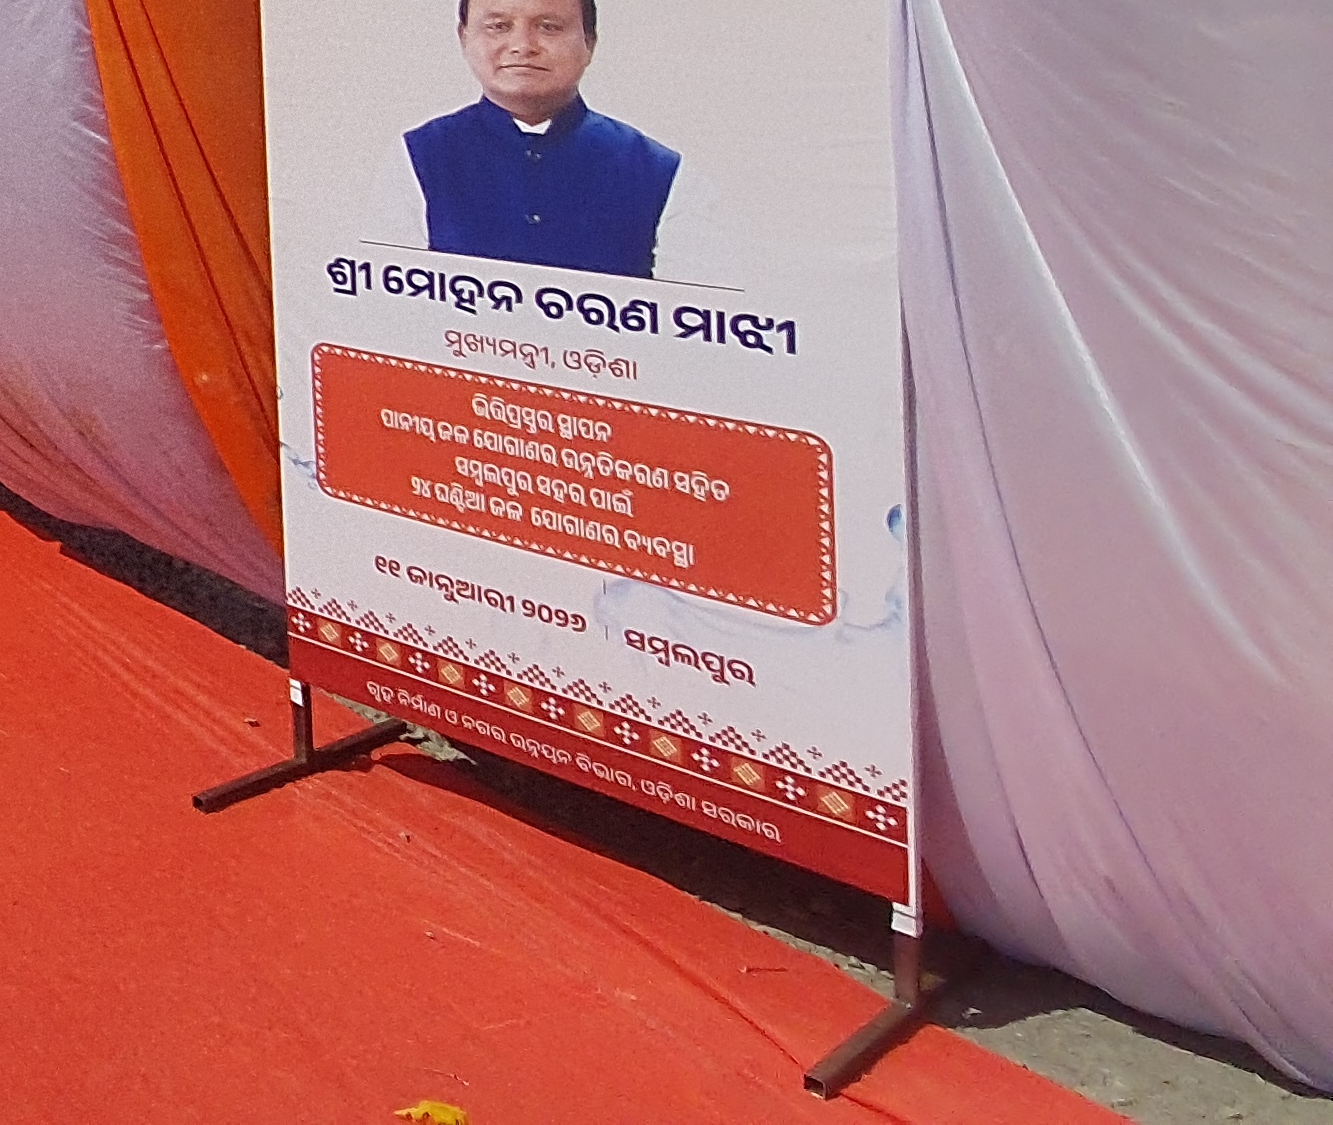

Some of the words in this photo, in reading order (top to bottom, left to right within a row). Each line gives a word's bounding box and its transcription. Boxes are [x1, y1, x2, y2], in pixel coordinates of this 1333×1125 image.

[327, 257, 372, 295] ଶ୍ରୀ
[383, 265, 523, 315] ମୋହନ
[535, 287, 659, 334] ଚରଣ
[672, 306, 797, 355] ମାଝୀ
[444, 329, 556, 369] ମୁଖ୍ୟମନ୍ତ୍ରୀ,
[563, 349, 637, 380] ଓଡ଼ିଶା
[380, 408, 436, 442] ପାନୀୟ
[437, 421, 469, 444] ଜଳ
[473, 428, 558, 467] ଯୋଗାଣର
[561, 448, 670, 489] ଉନ୍ନତିକରଣ
[674, 470, 730, 502] ସହିତ
[472, 392, 555, 433] ଭିତ୍ତିପ୍ରସ୍ତର
[557, 413, 612, 442] ସ୍ଥାପନ
[411, 475, 431, 498] ୨୪
[489, 496, 523, 522] ଜଳ
[531, 507, 621, 548] ଯୋଗାଣର
[624, 529, 695, 568] ବ୍ୟବସ୍ଥା
[455, 456, 534, 496] ସମ୍ବଲପୁର
[536, 475, 587, 506] ସହର
[590, 487, 633, 517] ପାଇଁ
[374, 554, 401, 579] ୧୧
[406, 565, 516, 613] ଜାନୁଆରୀ
[521, 599, 588, 633] ୨୦୨୬
[623, 628, 756, 687] ସମ୍ବଲପୁର
[366, 681, 394, 703] ଗୃହ
[397, 688, 441, 719] ନିର୍ମାଣ
[445, 709, 458, 725] ଓ
[461, 715, 507, 744] ନଗର
[509, 733, 572, 764] ଉନ୍ନୟନ
[641, 779, 696, 810] ଓଡ଼ିଶା
[701, 799, 781, 843] ସରକାର
